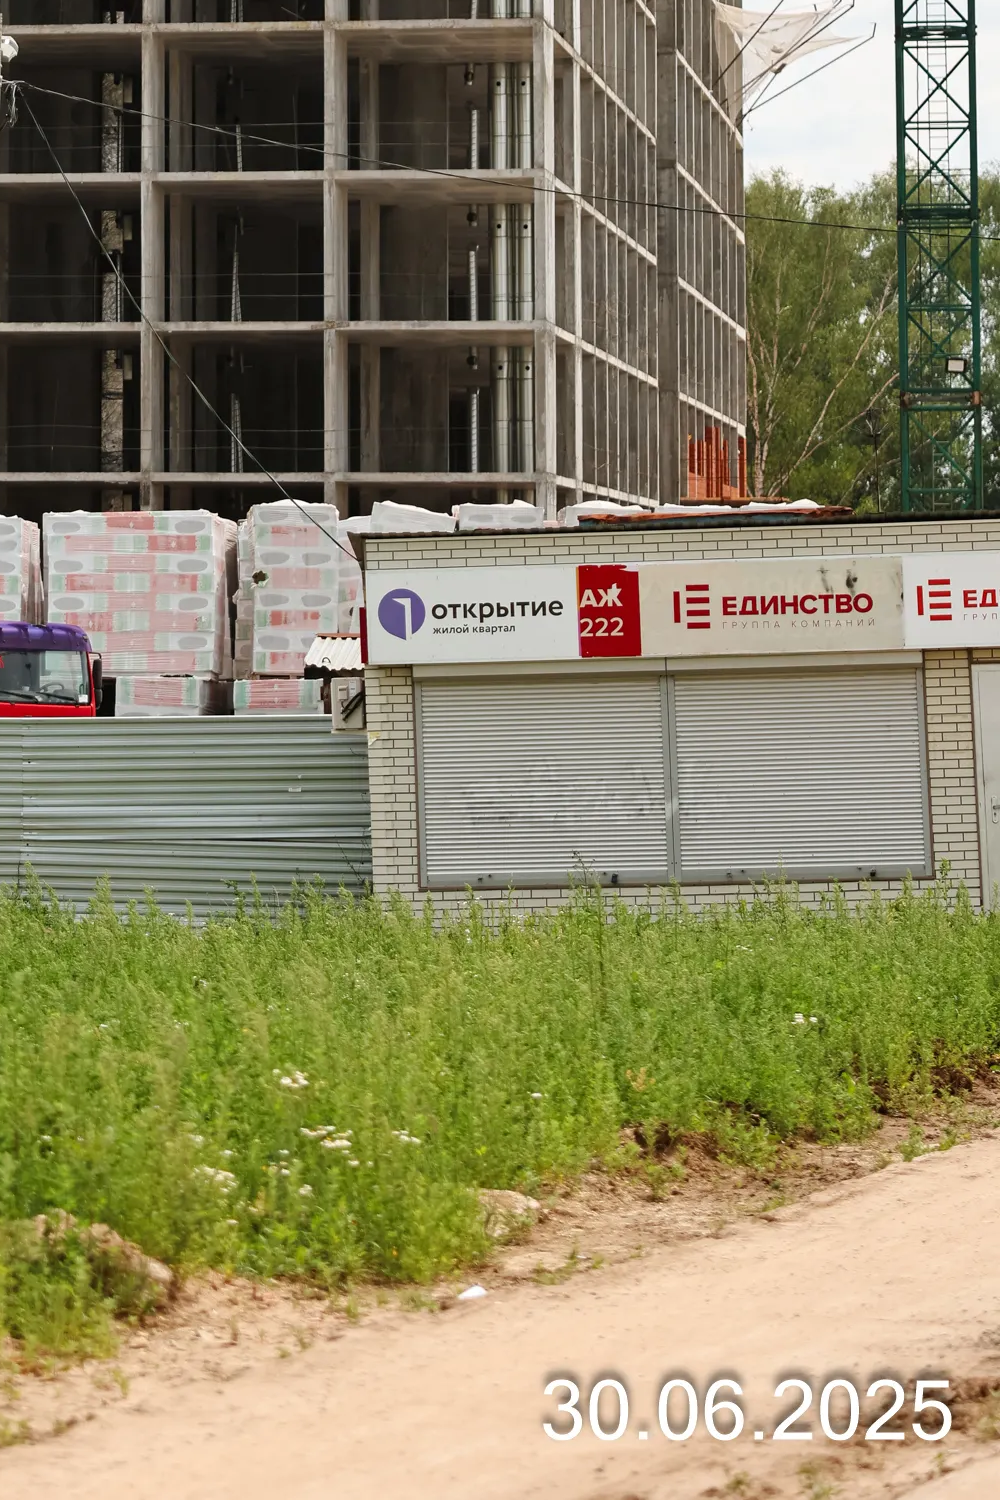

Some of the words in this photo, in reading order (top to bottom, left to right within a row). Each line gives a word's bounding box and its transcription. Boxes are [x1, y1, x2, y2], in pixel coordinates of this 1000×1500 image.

[722, 593, 874, 615] ЕДИНСТВО
[963, 589, 1000, 608] ЕД
[431, 600, 564, 622] открытие
[432, 624, 470, 634] жилой
[472, 624, 516, 634] квартал
[580, 617, 624, 637] 222
[722, 620, 781, 629] ГРУППА
[791, 618, 876, 628] КОМПАНИЙ
